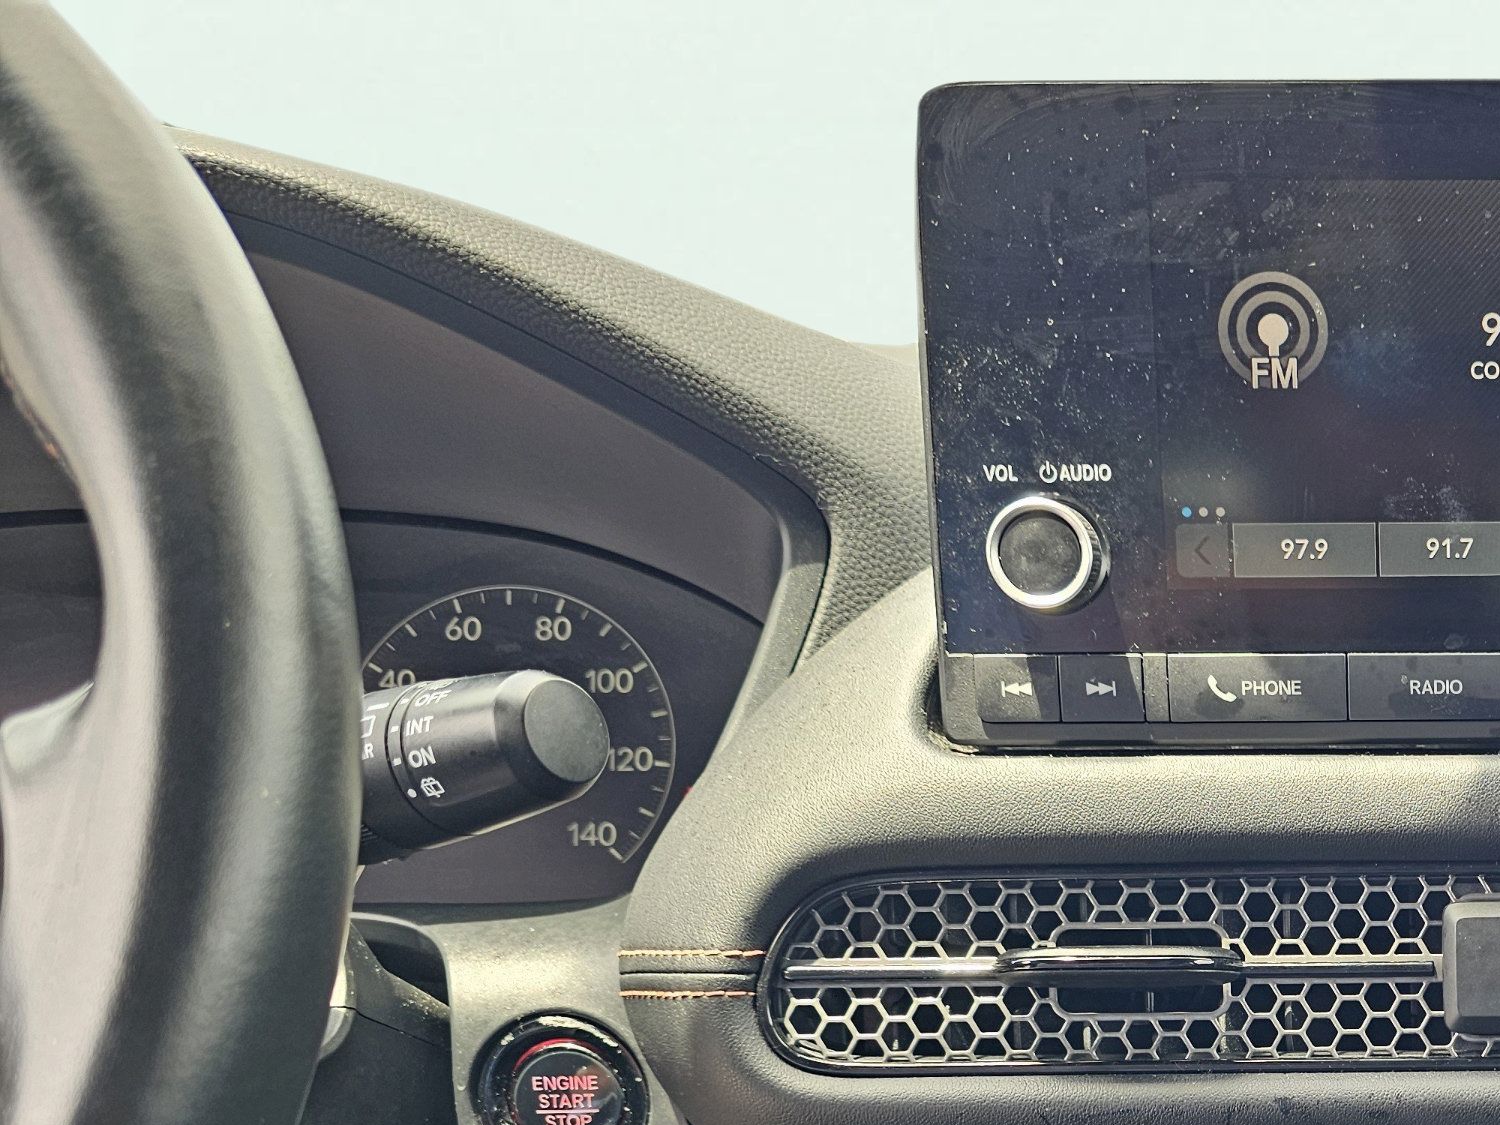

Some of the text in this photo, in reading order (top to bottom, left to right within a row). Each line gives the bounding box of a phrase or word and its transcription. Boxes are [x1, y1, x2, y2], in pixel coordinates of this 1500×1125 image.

[1252, 357, 1298, 389] FM
[983, 465, 1018, 481] VOL
[1060, 464, 1111, 481] AUDIO
[1281, 539, 1327, 559] 97.9
[1427, 538, 1473, 558] 91.7
[445, 617, 481, 640] 60
[536, 617, 571, 640] 80
[585, 669, 633, 694] 100
[1241, 679, 1301, 695] PHONE
[1410, 680, 1462, 694] RADIO
[415, 690, 452, 707] OFF
[406, 716, 433, 736] INT
[408, 746, 436, 768] ON
[609, 746, 653, 771] 120
[567, 822, 616, 847] 140
[532, 1075, 598, 1090] ENGINE
[538, 1093, 595, 1109] START
